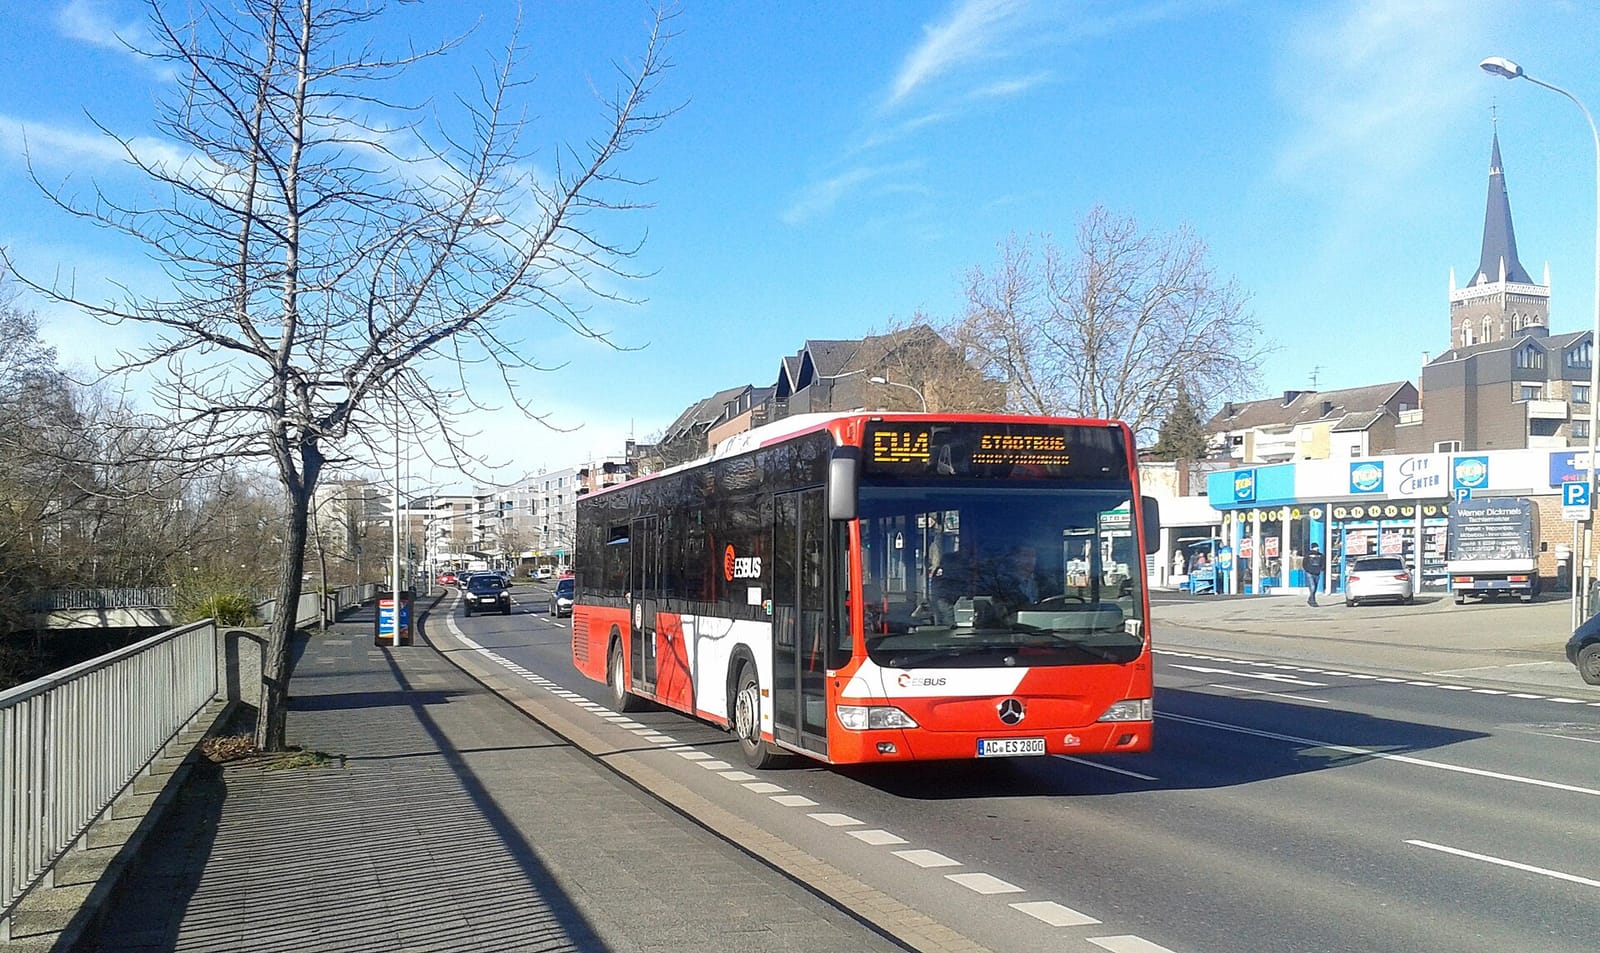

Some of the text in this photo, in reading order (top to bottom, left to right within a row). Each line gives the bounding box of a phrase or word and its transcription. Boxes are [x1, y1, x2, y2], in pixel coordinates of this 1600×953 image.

[981, 435, 1066, 450] STADTBUS
[1568, 485, 1584, 505] P
[733, 556, 762, 579] ESBUS
[985, 740, 1044, 753] AC ES 2800
